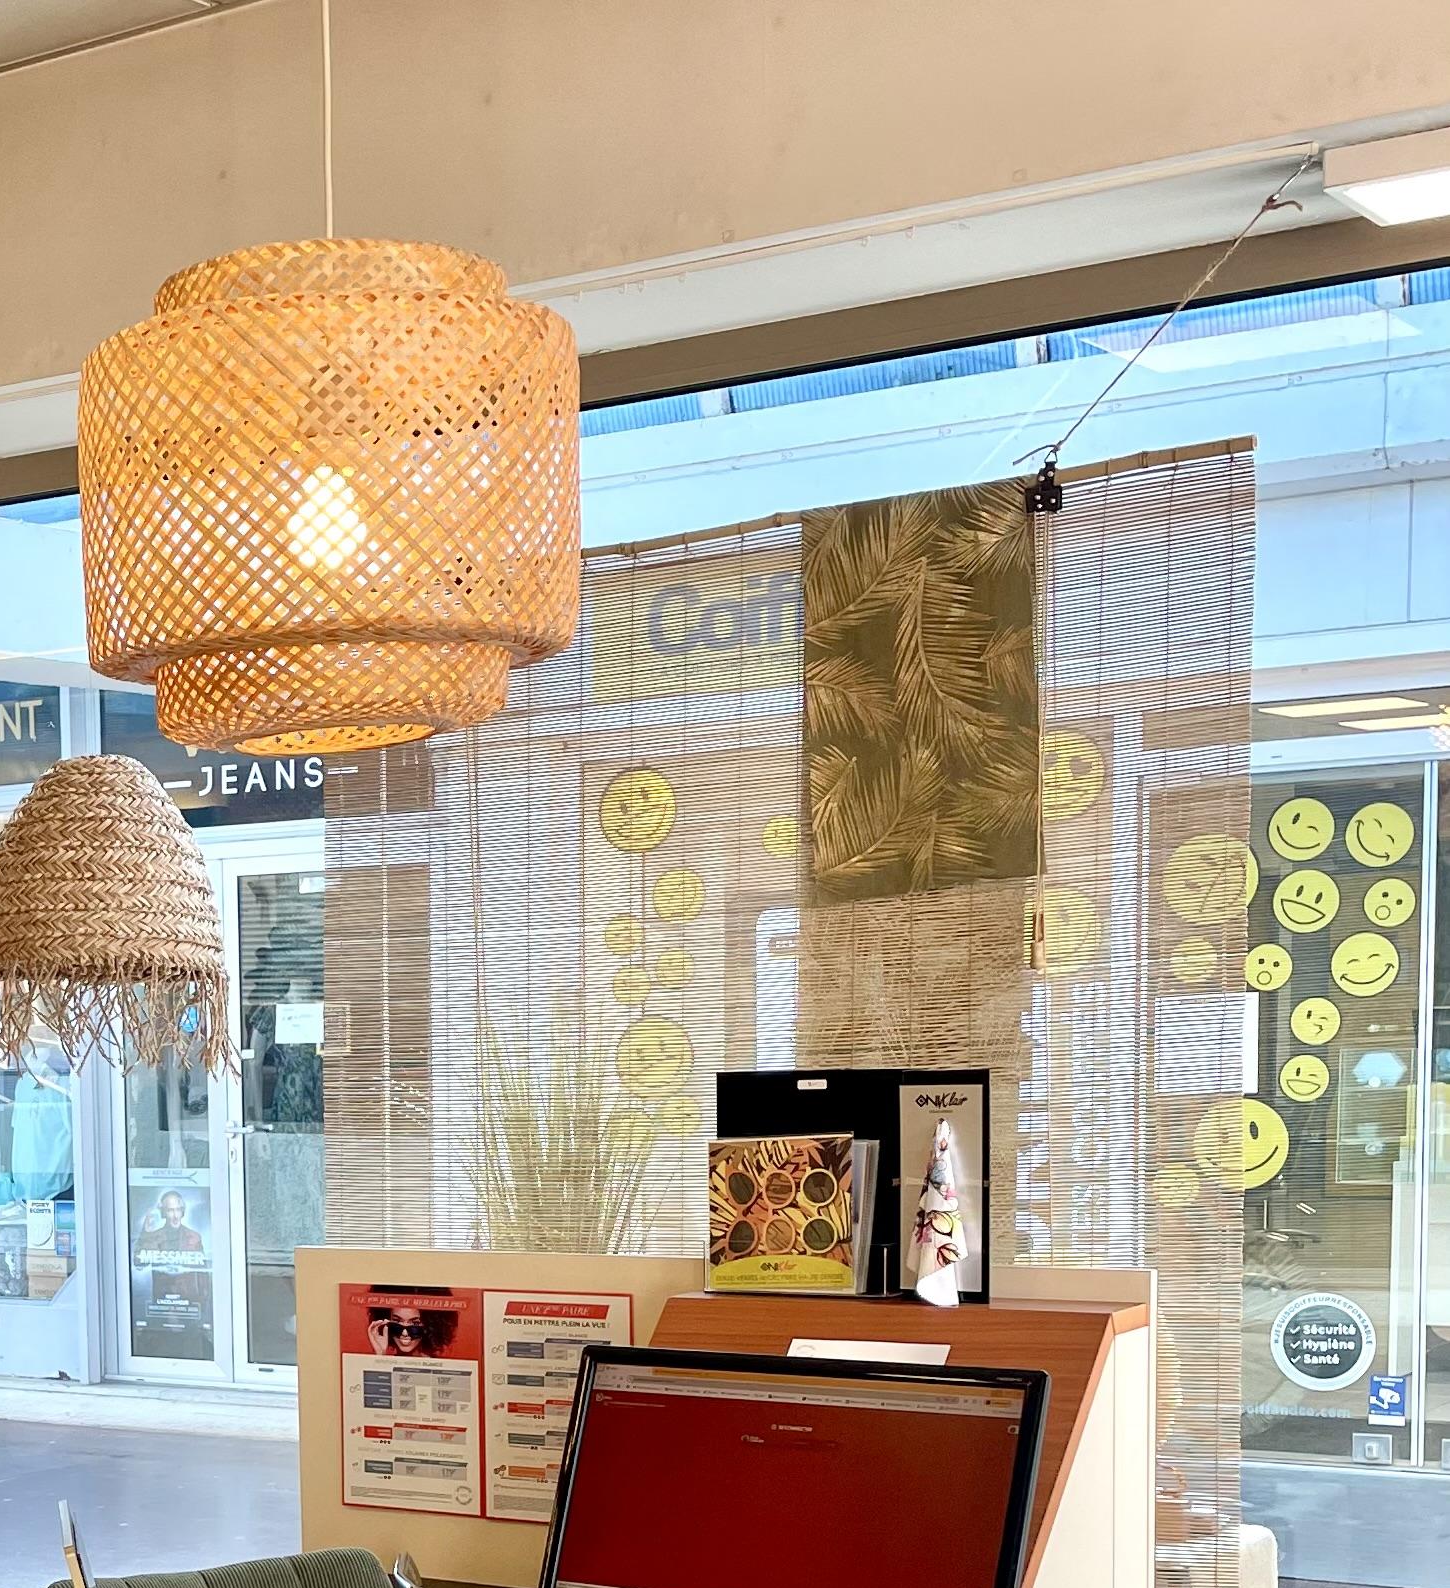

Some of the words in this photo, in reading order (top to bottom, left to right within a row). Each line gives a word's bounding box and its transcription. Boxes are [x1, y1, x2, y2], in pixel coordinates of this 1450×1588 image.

[198, 756, 324, 797] JEANS
[561, 1320, 581, 1328] PLEIN
[1302, 1323, 1356, 1336] Sécurité
[1302, 1338, 1355, 1351] Hygiène
[1303, 1353, 1340, 1365] Santé
